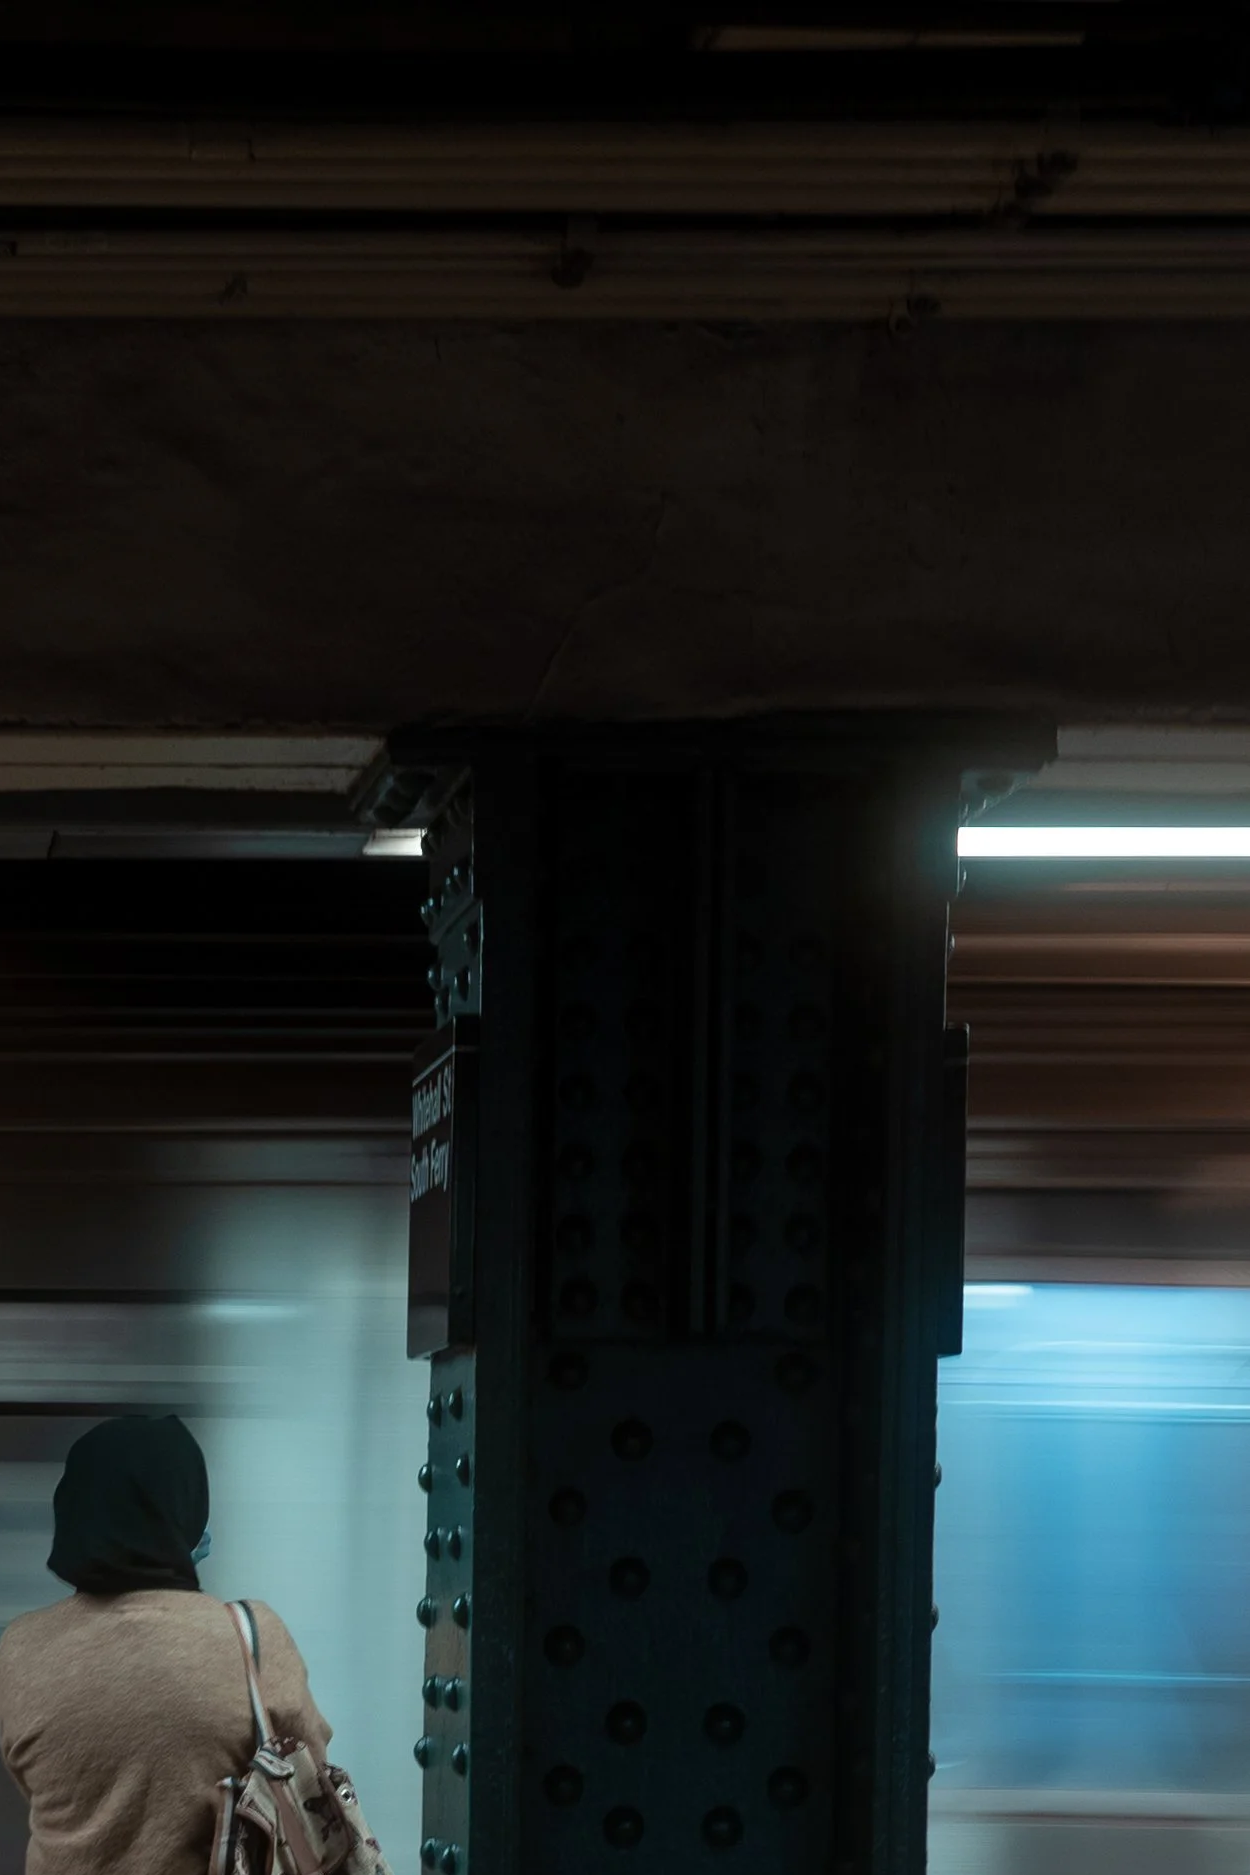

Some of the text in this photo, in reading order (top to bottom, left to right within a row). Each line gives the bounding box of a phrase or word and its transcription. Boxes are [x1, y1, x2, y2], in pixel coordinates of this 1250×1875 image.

[412, 1063, 452, 1141] Whitehall St
[410, 1138, 450, 1204] South Ferry
